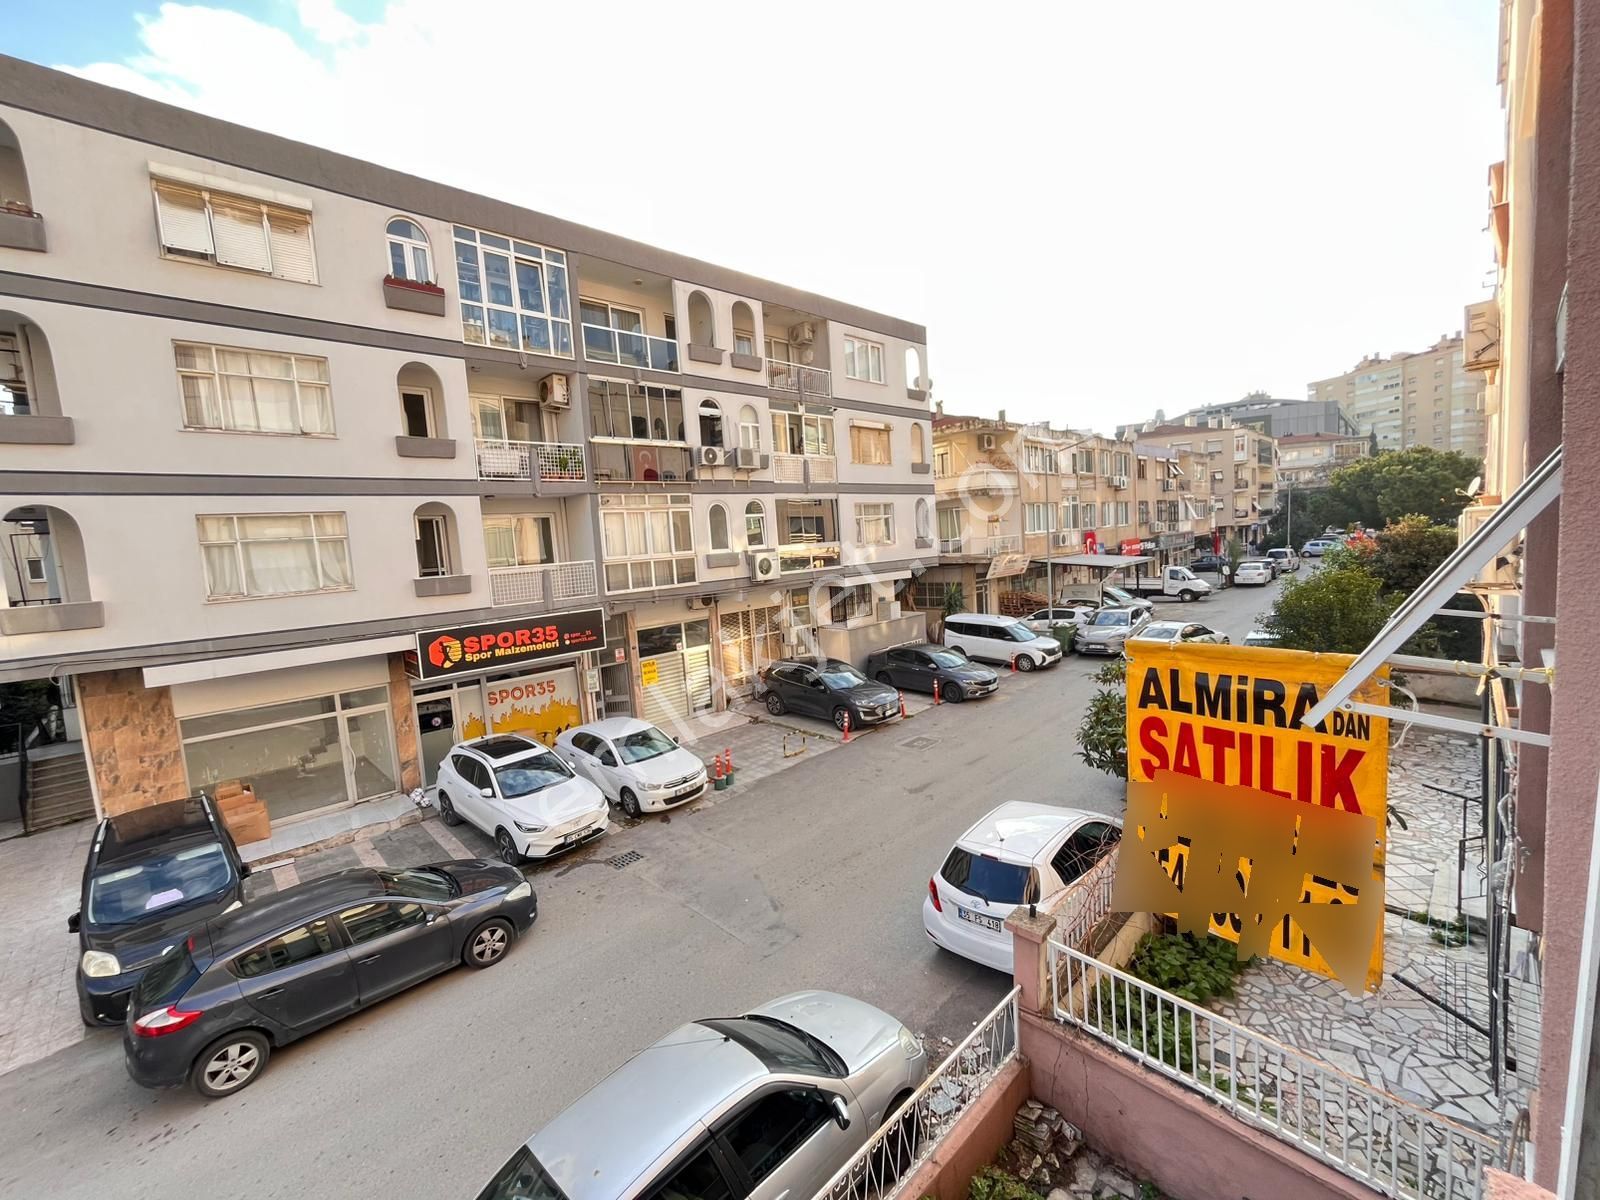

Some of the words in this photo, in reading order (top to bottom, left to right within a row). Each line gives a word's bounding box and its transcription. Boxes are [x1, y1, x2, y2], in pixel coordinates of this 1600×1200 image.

[463, 625, 559, 653] SPOR35
[464, 651, 492, 664] Spor
[494, 640, 560, 658] Malzemeleri
[487, 679, 556, 706] SPOR35
[1332, 711, 1371, 742] DAN
[1139, 715, 1366, 815] SATILIK
